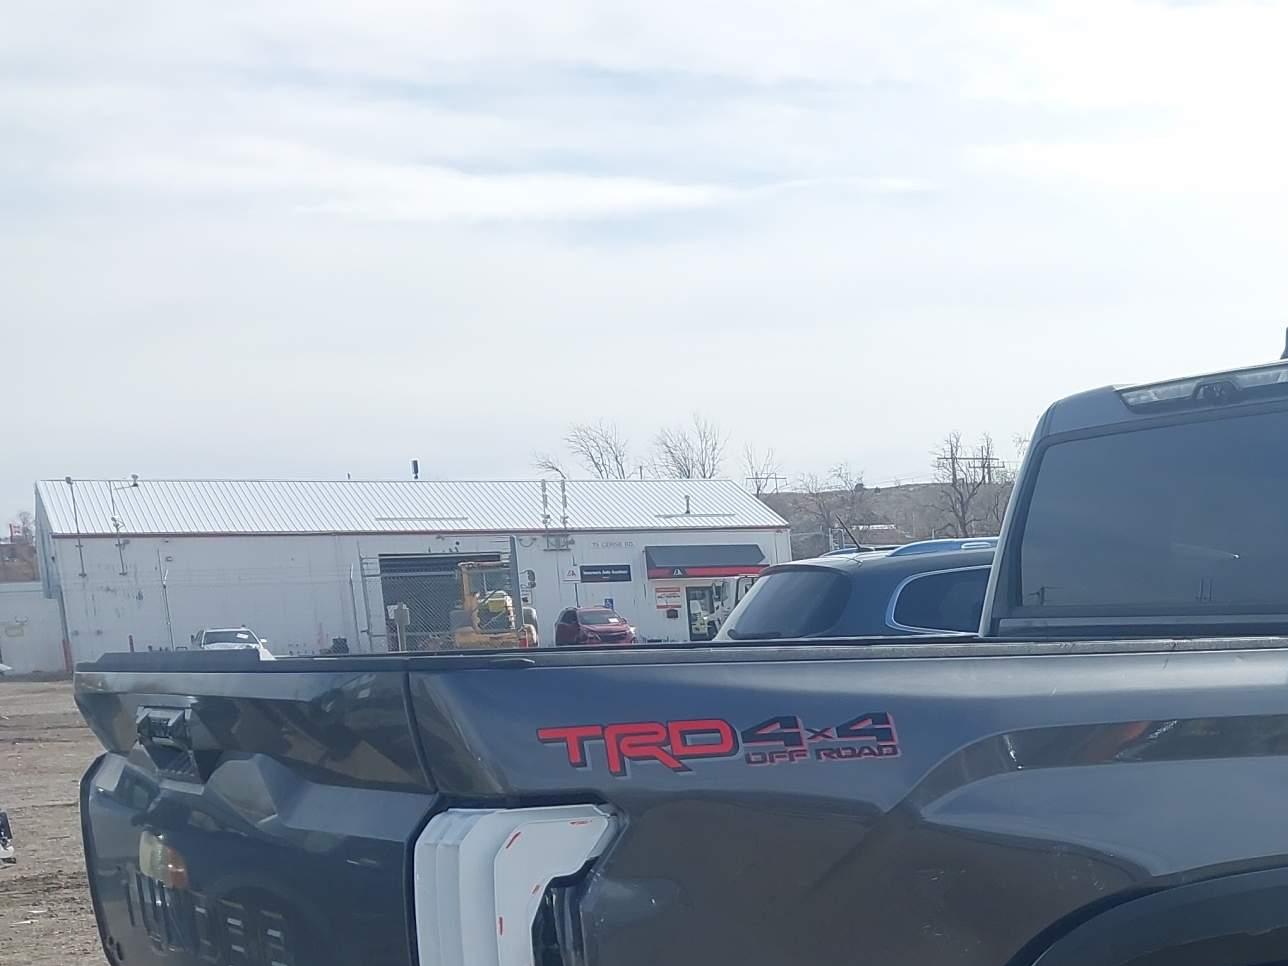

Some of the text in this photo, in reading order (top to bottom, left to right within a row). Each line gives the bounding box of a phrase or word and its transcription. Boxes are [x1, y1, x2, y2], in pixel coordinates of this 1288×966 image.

[536, 712, 896, 778] TRD 4x4
[745, 744, 898, 765] OFF ROAD
